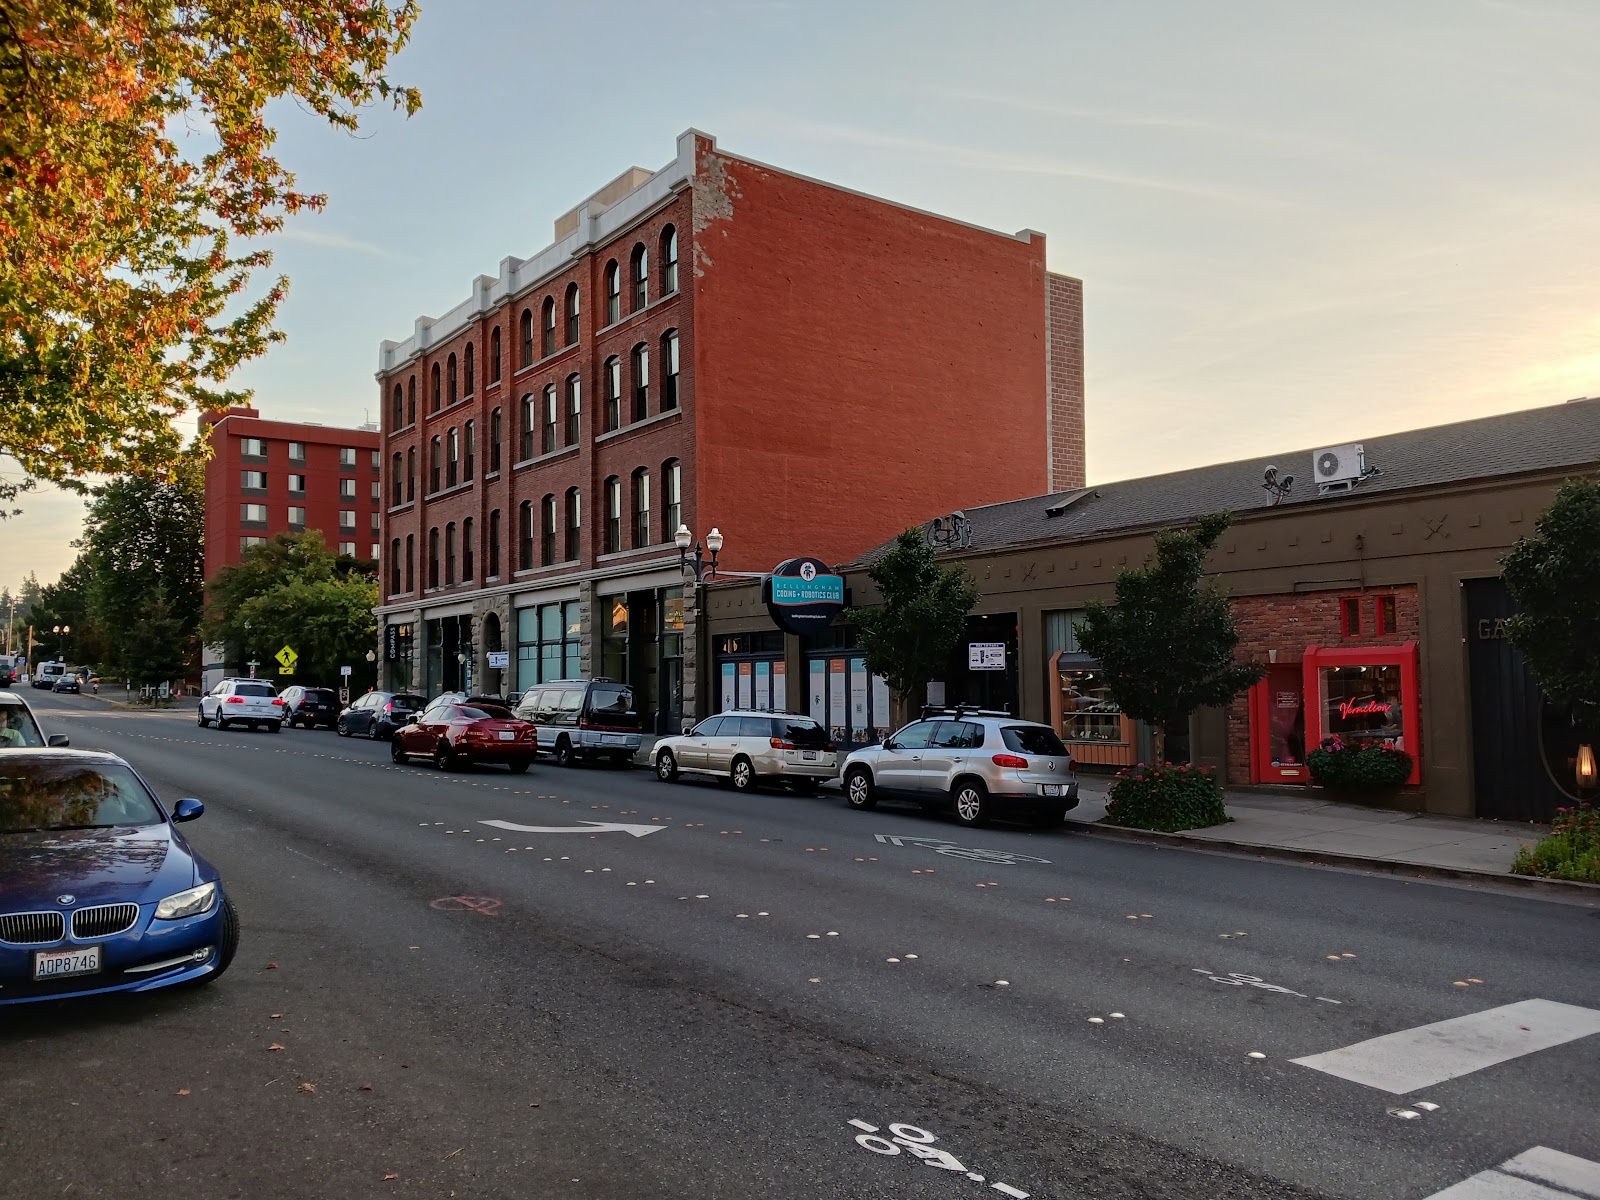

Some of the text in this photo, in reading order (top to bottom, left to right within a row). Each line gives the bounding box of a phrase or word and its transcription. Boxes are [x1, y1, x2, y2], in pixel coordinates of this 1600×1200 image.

[776, 583, 840, 591] BELLINGHAM
[776, 590, 797, 598] CODING
[801, 590, 826, 599] ROBOTICS
[826, 591, 840, 600] CLUB
[38, 954, 96, 974] ADP8746
